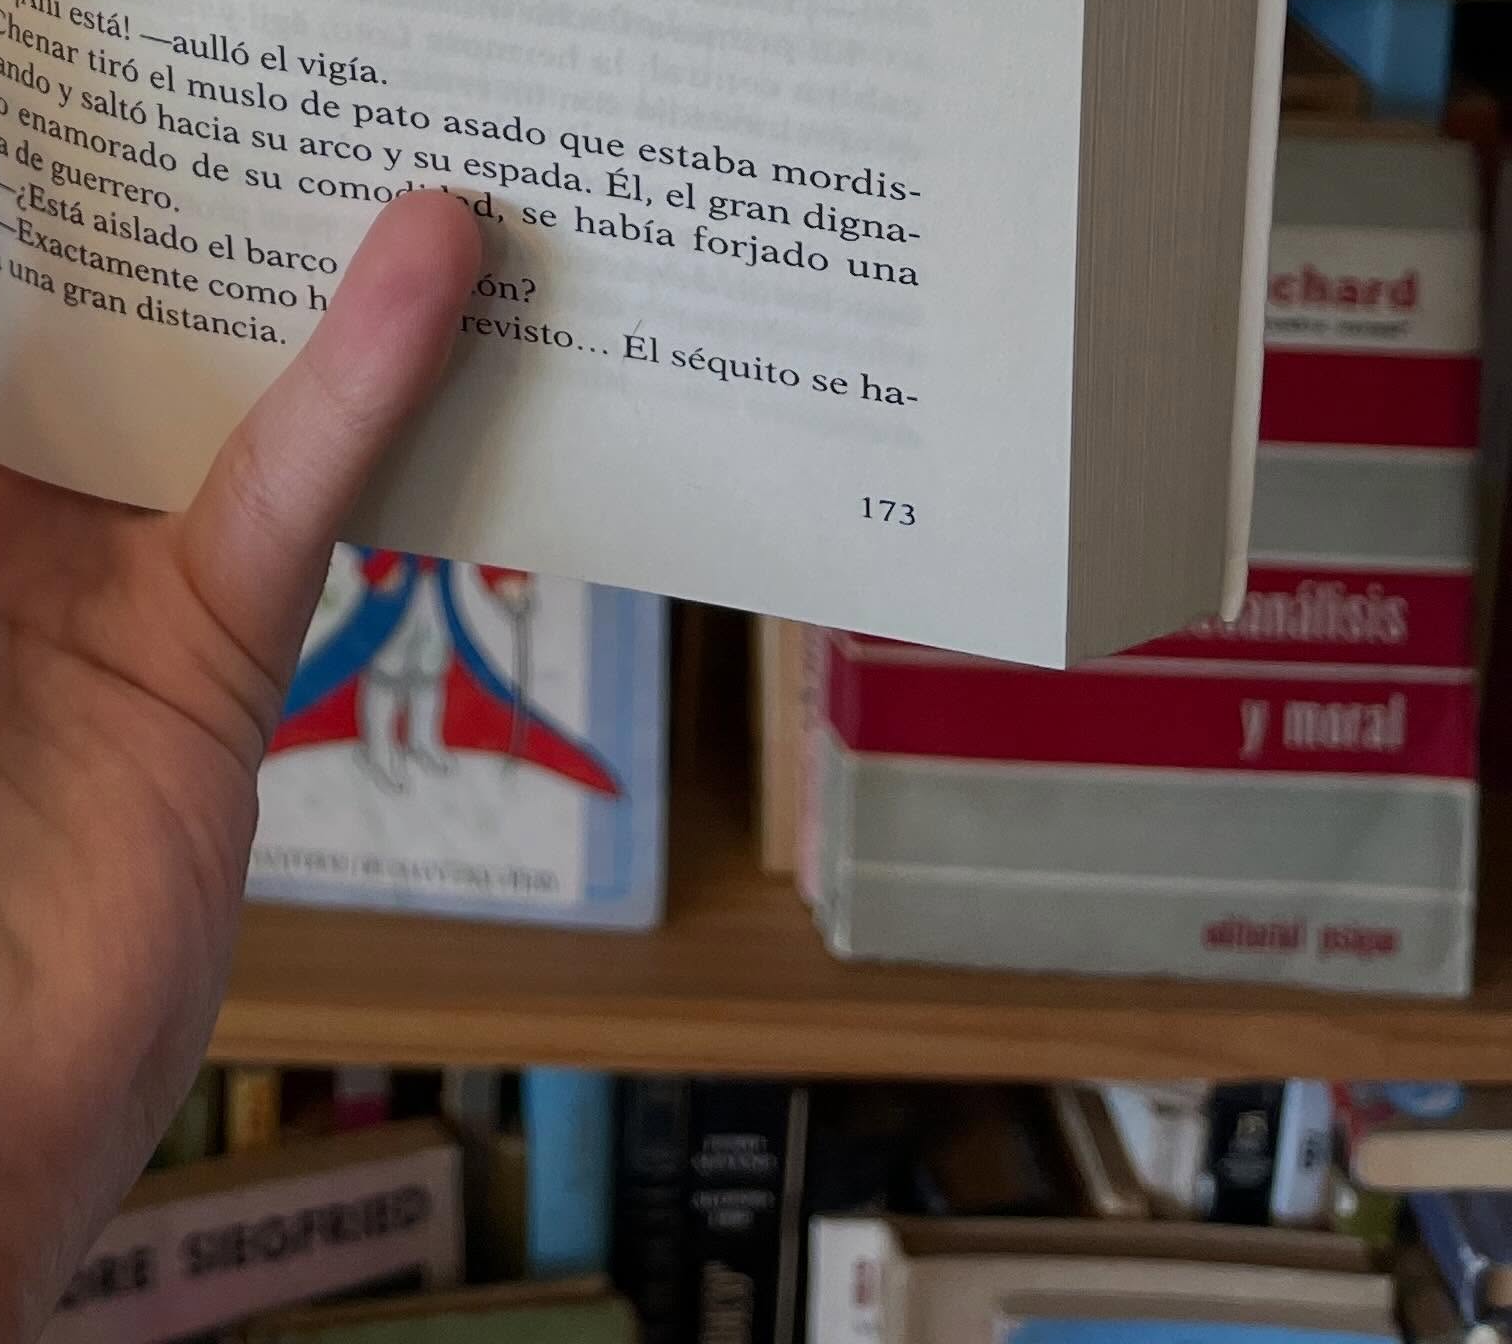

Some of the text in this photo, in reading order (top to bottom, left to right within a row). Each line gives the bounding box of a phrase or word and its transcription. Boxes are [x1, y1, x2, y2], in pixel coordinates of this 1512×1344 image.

[69, 6, 130, 41] está!
[260, 44, 289, 73] el
[296, 52, 388, 87] vigía.
[15, 139, 44, 173] de
[50, 160, 180, 213] guerrero.
[8, 259, 56, 295] una
[63, 281, 129, 316] gran
[135, 295, 286, 345] distancia.
[1271, 264, 1419, 311] chard
[670, 347, 800, 383] séquito
[810, 371, 849, 397] se
[859, 373, 919, 406] ha-
[861, 496, 916, 526] 173
[1240, 692, 1409, 761] y moral
